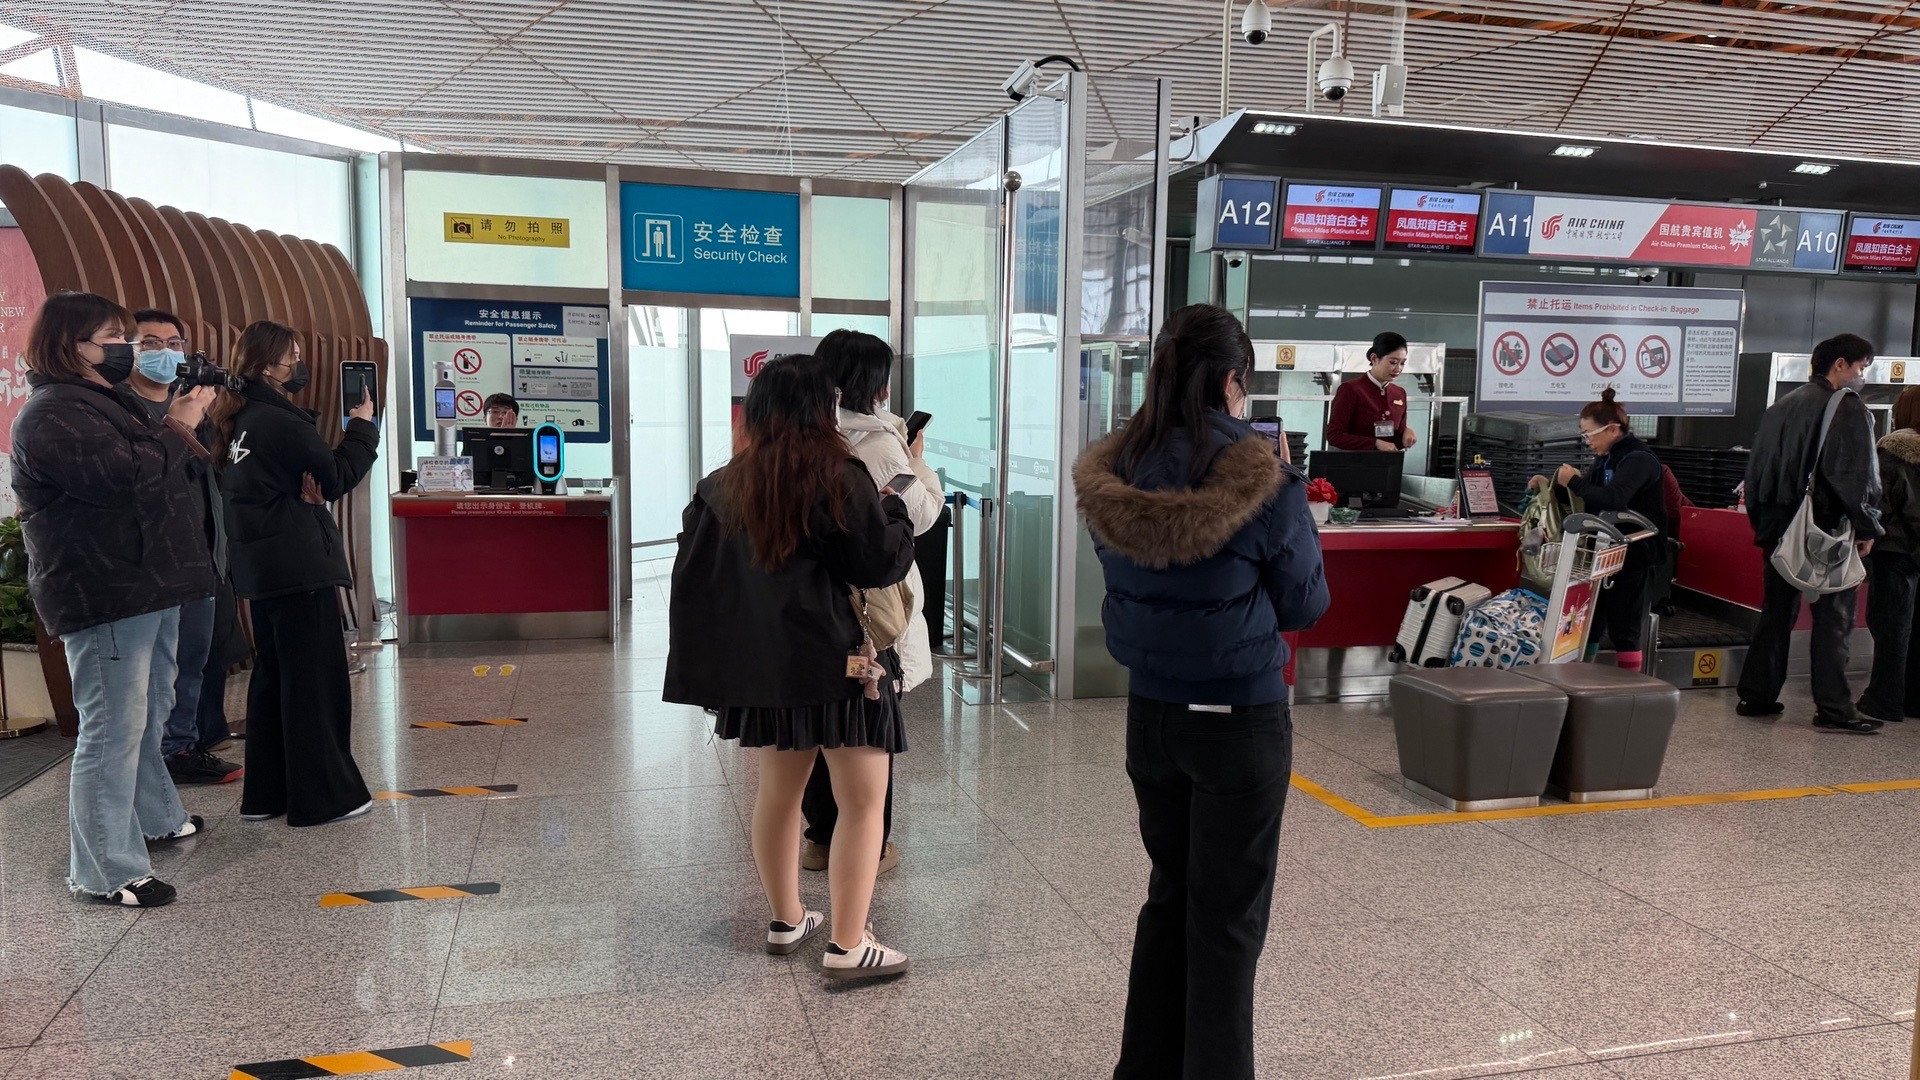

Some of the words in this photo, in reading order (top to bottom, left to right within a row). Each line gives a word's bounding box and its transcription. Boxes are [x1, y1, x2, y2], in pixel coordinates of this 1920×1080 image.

[1219, 199, 1271, 226] A12
[1294, 212, 1369, 227] 凤凰知音白金卡
[480, 218, 563, 235] 请勿拍照
[1396, 217, 1468, 233] 凤凰知音白金卡
[1488, 212, 1532, 238] A11
[1567, 217, 1587, 228] AIR
[1589, 218, 1625, 230] CHINA
[1659, 223, 1724, 239] 国航贵宾值机
[508, 234, 545, 242] Photography
[693, 221, 783, 247] 安全检查
[1330, 227, 1355, 235] Platinum
[1355, 228, 1370, 236] Card
[1392, 230, 1415, 238] Phoenix
[1660, 240, 1676, 248] China
[1676, 241, 1701, 249] Premium
[1796, 229, 1838, 254] A10
[1854, 242, 1913, 255] 凤凰知音白金卡
[694, 247, 745, 264] Security
[748, 250, 788, 264] Check
[0, 306, 26, 318] NEW
[1526, 298, 1572, 311] 禁止托运
[1594, 303, 1630, 311] Prohibited
[1630, 304, 1637, 312] in
[1638, 304, 1668, 313] Check-in
[1670, 305, 1700, 315] Baggage
[479, 309, 542, 320] 安全信息提示
[464, 319, 494, 327] Reminder
[505, 321, 537, 330] Passenger
[538, 322, 557, 330] Safety
